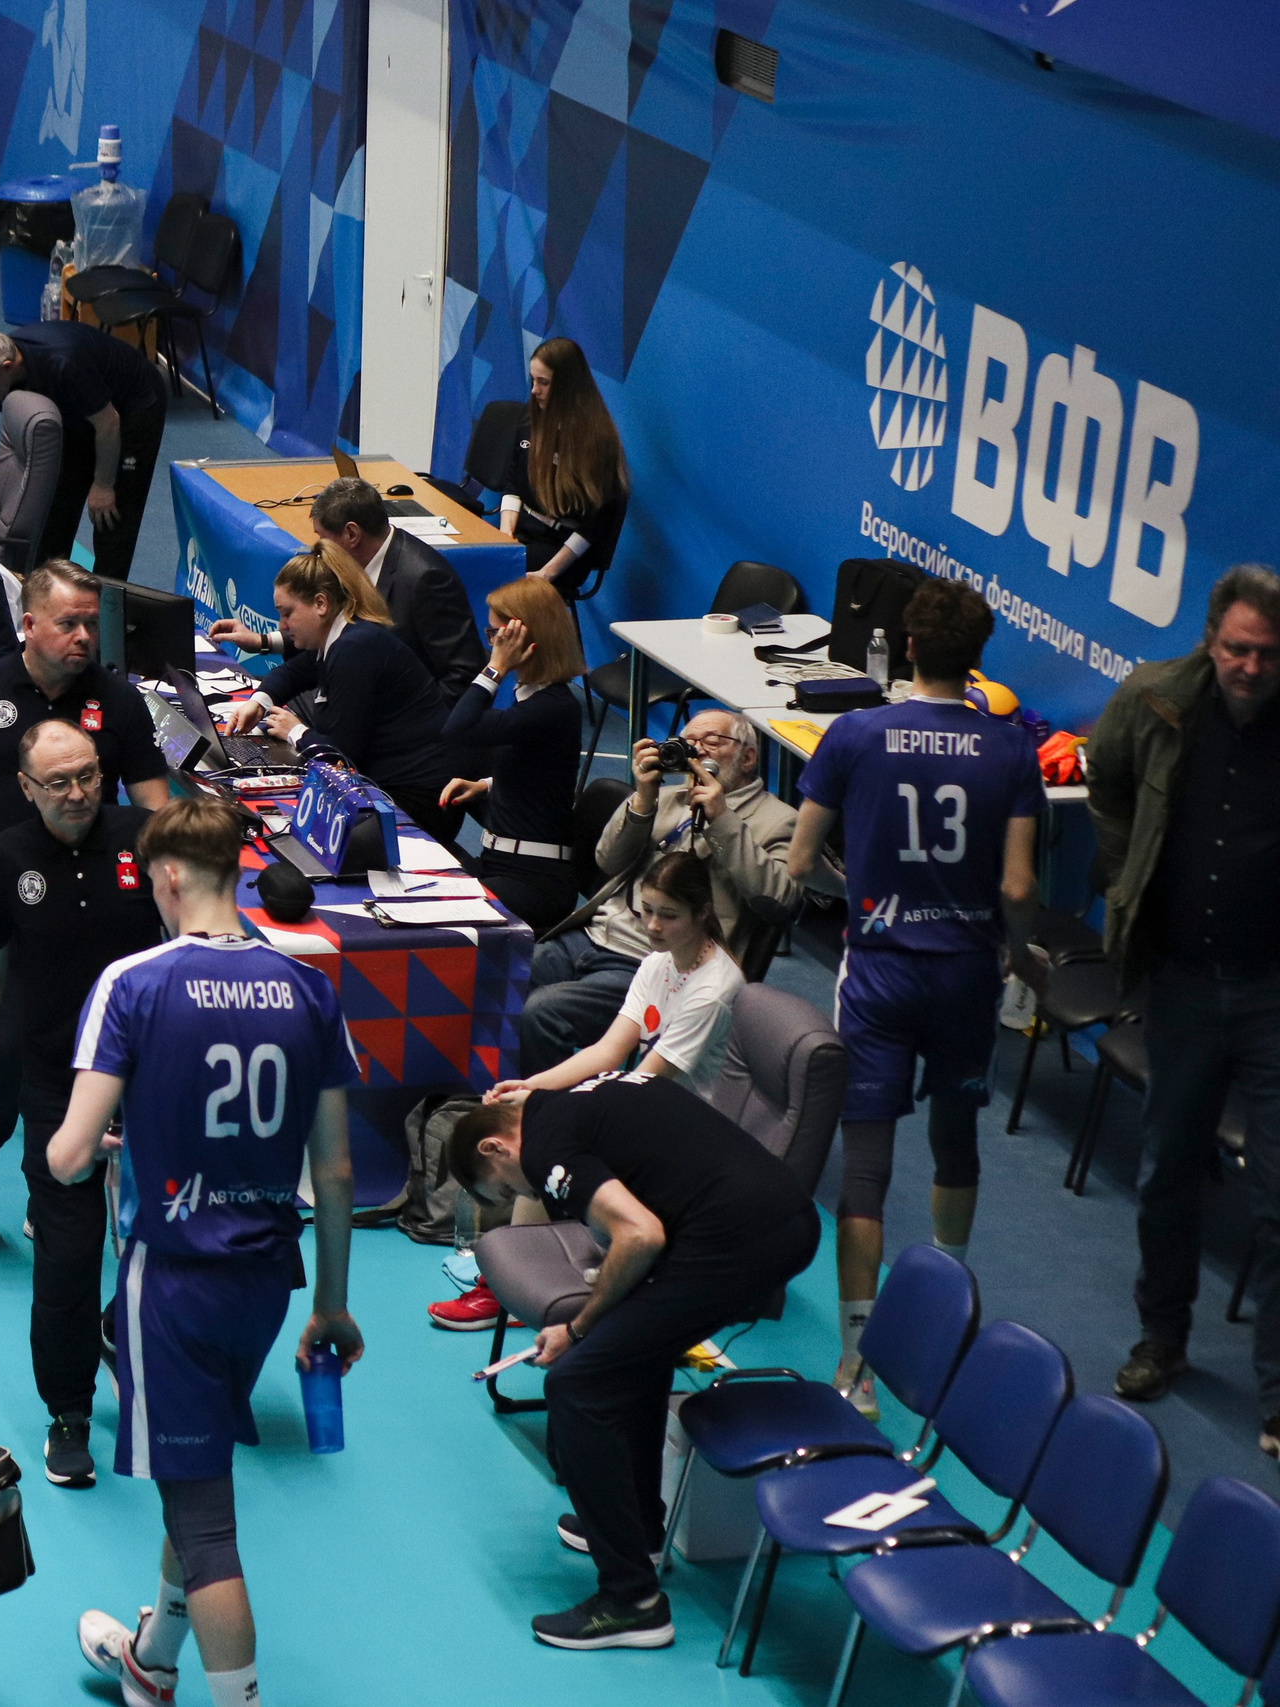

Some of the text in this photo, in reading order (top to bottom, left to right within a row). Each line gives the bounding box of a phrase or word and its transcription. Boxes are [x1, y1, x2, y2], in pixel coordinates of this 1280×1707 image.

[951, 303, 1200, 628] ВФВ
[986, 573, 1086, 662] федерация
[885, 728, 982, 757] ШЕРПЕТИС
[897, 783, 968, 864] 13
[186, 979, 295, 1010] ЧЕКМИЗОВ
[204, 1043, 288, 1139] 20
